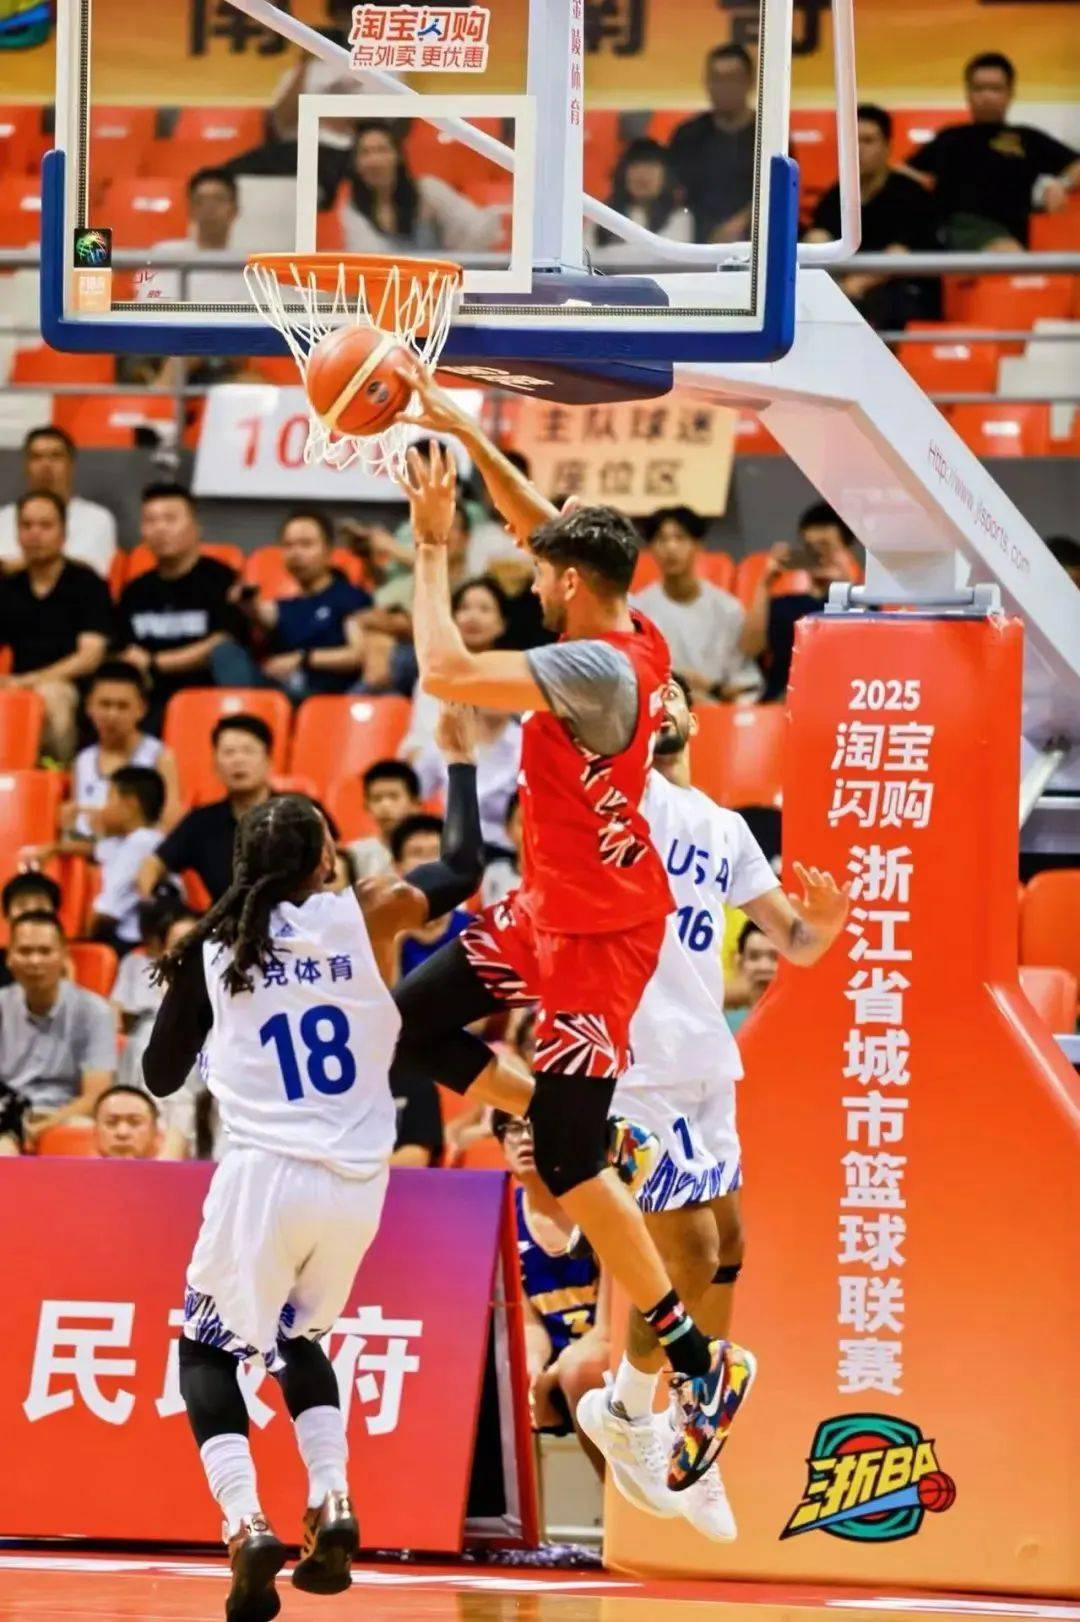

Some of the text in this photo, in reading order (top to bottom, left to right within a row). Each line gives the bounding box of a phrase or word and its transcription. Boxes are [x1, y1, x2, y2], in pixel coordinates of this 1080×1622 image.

[353, 9, 486, 42] 淘宝闪购
[352, 46, 485, 68] 点外卖 更优惠
[535, 405, 715, 446] 主队球迷
[849, 679, 921, 711] 2025
[830, 720, 936, 772] 淘宝
[827, 778, 936, 829] 闪购
[667, 838, 730, 893] USA
[677, 905, 714, 952] 16
[260, 1004, 357, 1101] 18
[837, 844, 913, 1397] 浙江省城市篮球联赛
